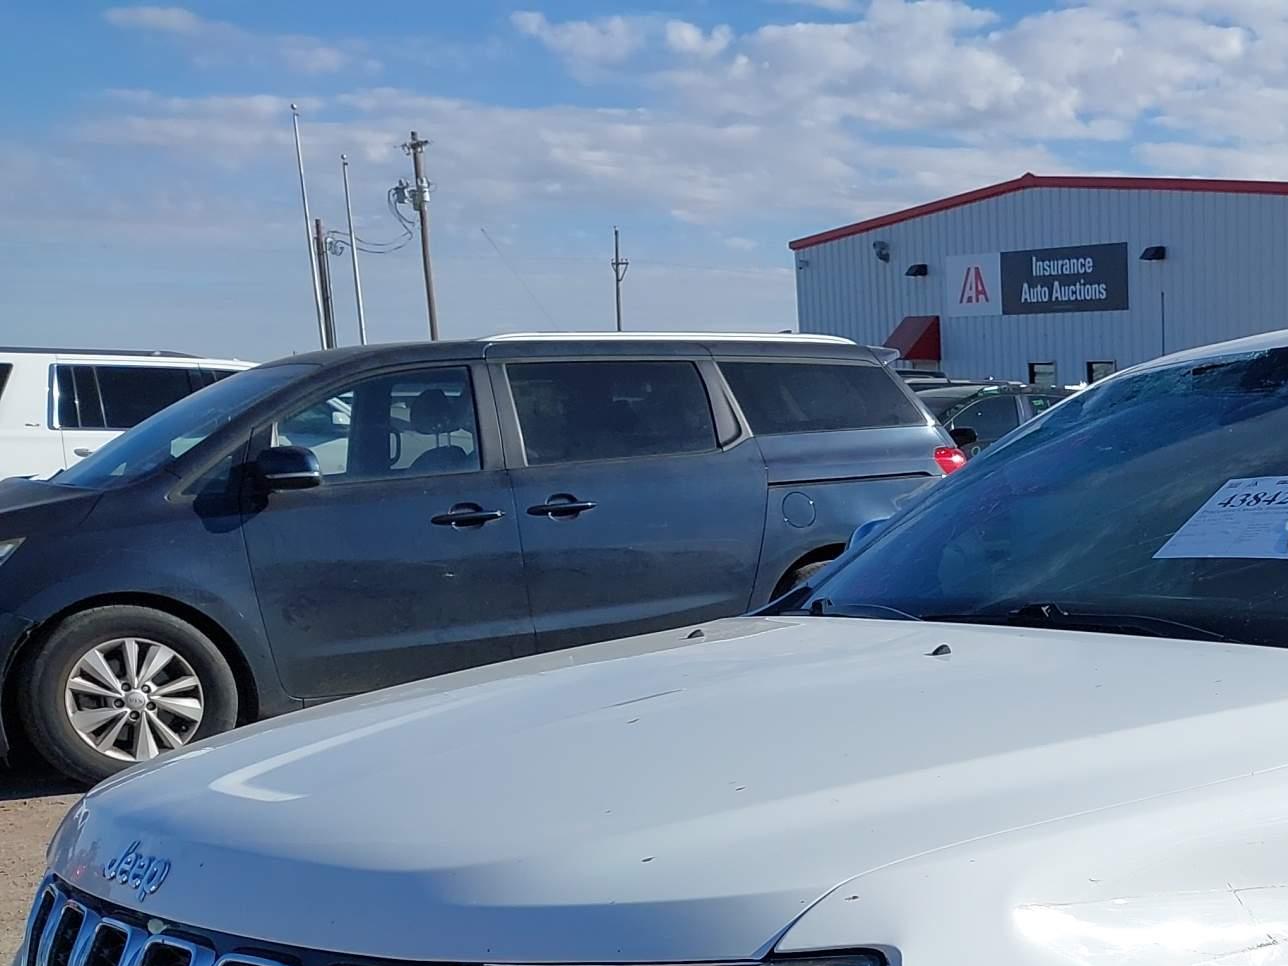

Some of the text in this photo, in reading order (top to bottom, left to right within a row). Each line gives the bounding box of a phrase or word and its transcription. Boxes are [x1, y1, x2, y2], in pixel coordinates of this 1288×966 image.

[1032, 256, 1093, 277] Insurance
[1021, 279, 1107, 303] Auto Auctions
[102, 839, 171, 903] Jeep
